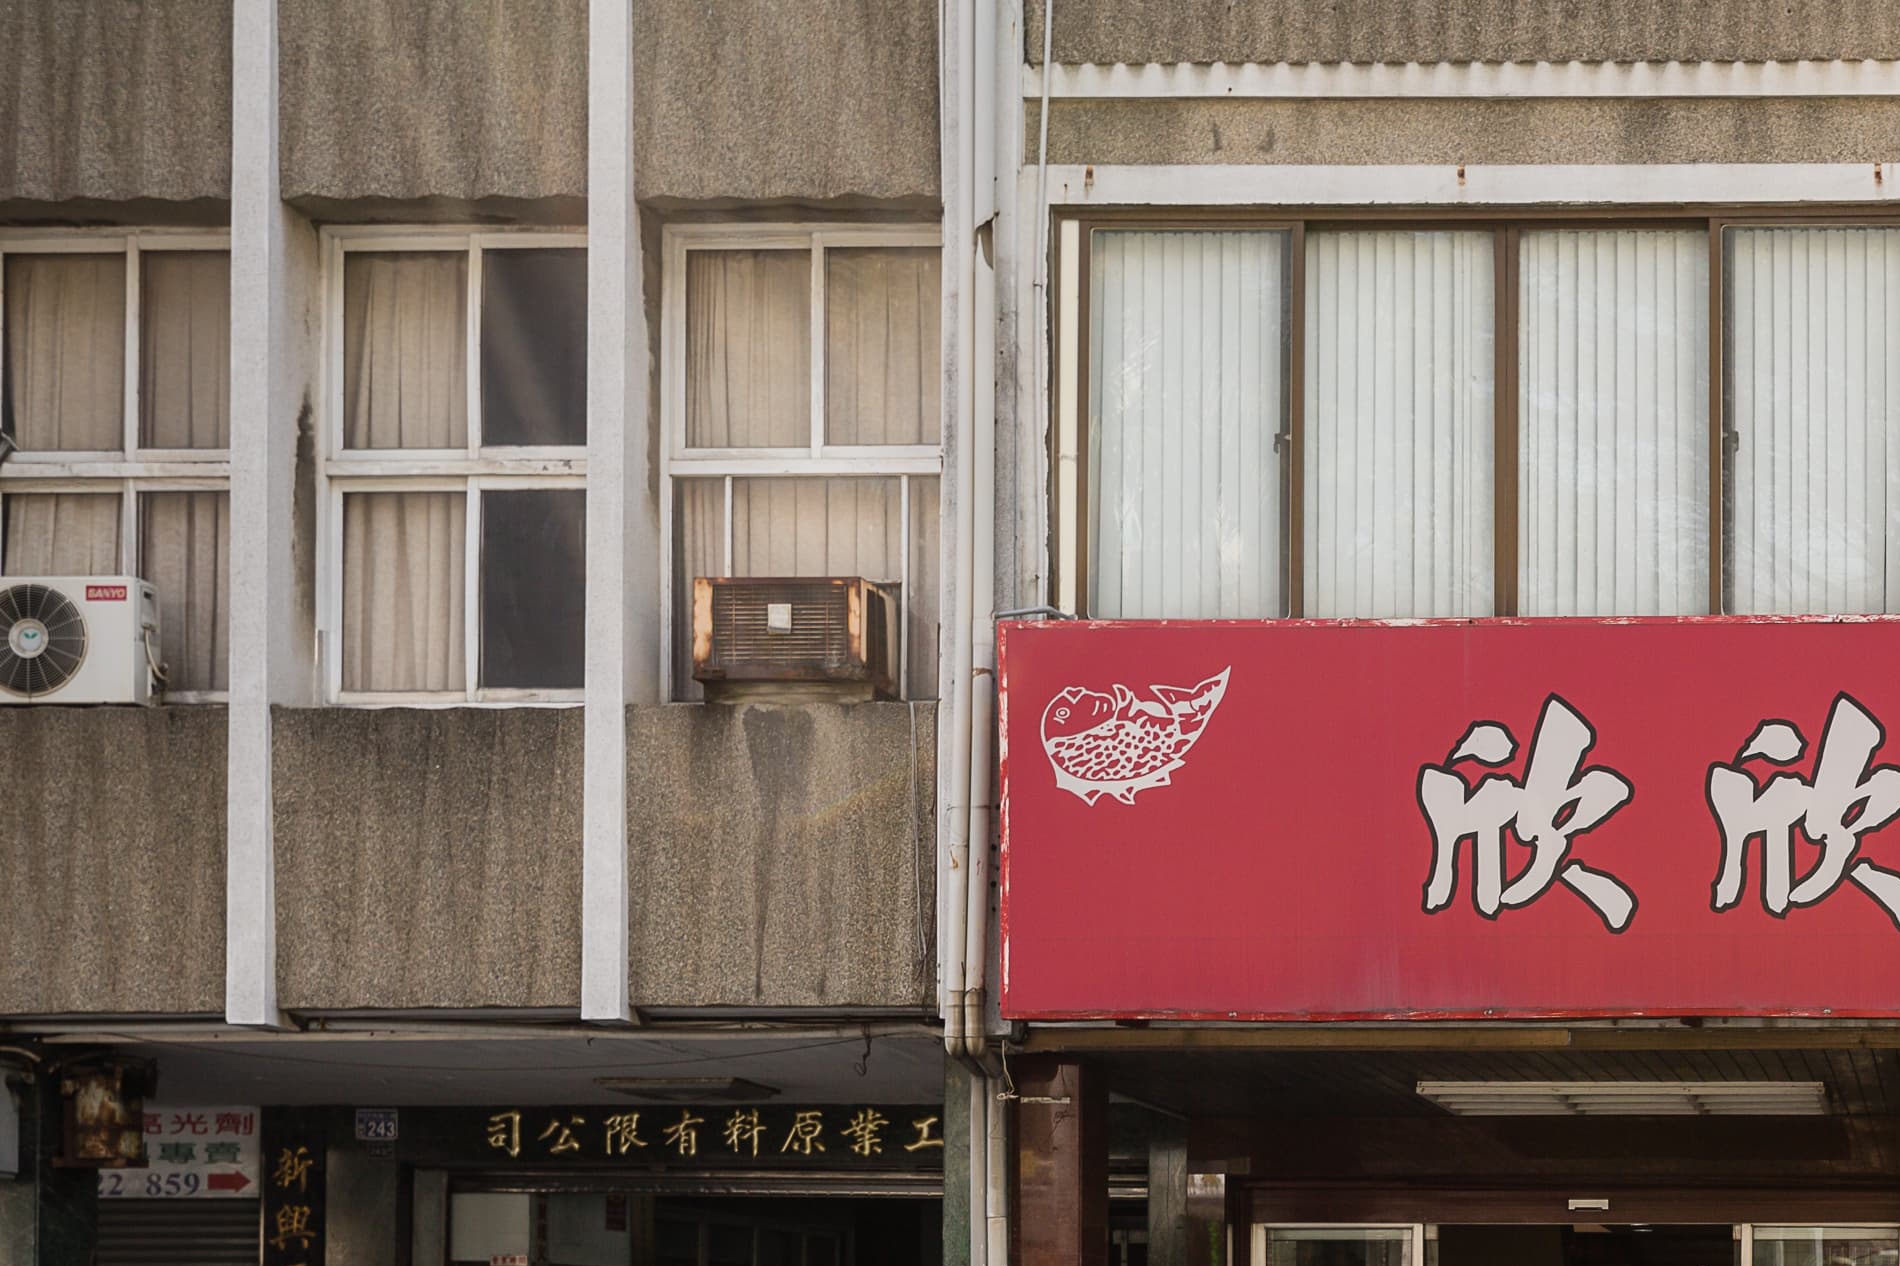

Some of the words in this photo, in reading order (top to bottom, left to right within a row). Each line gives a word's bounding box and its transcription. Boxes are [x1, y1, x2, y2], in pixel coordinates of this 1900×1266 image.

[88, 588, 125, 600] SANYO
[367, 1120, 396, 1137] 243
[143, 1142, 242, 1164] 專賣
[146, 1173, 200, 1196] 859
